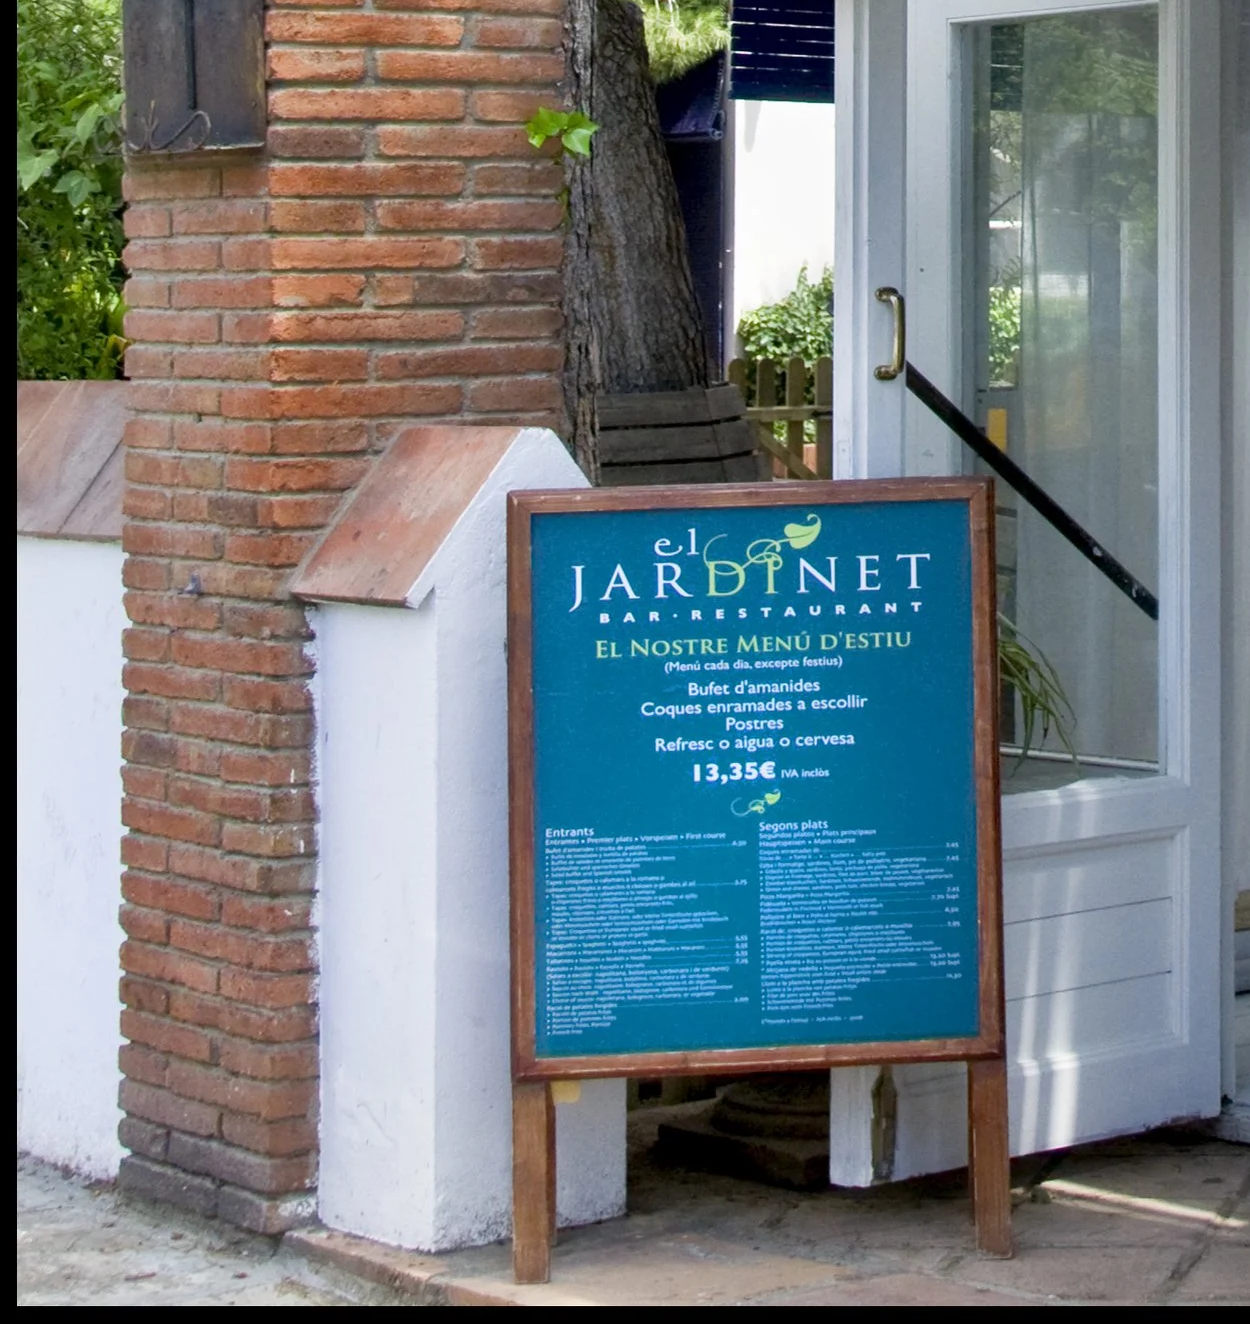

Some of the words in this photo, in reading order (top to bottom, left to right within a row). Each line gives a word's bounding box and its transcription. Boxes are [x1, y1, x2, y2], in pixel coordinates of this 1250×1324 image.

[654, 527, 700, 557] el
[569, 552, 931, 613] JARDINET
[665, 661, 700, 673] (Menú
[704, 660, 729, 670] cada
[755, 658, 799, 670] excepte
[803, 656, 843, 668] festius)
[688, 682, 729, 696] Bufet
[735, 679, 820, 694] d'amanides
[641, 702, 702, 718] Coques
[707, 699, 792, 714] enramades
[797, 700, 805, 710] a
[811, 695, 868, 709] escollir
[726, 717, 784, 731] Postres
[655, 738, 713, 751] Refresc
[719, 740, 729, 749] o
[735, 735, 774, 752] aigua
[780, 736, 790, 746] o
[796, 734, 854, 746] cervesa
[693, 761, 775, 784] 13,35€
[781, 769, 798, 778] IVA
[545, 828, 594, 838] Entrants
[759, 821, 798, 832] Segons
[801, 819, 828, 831] plats
